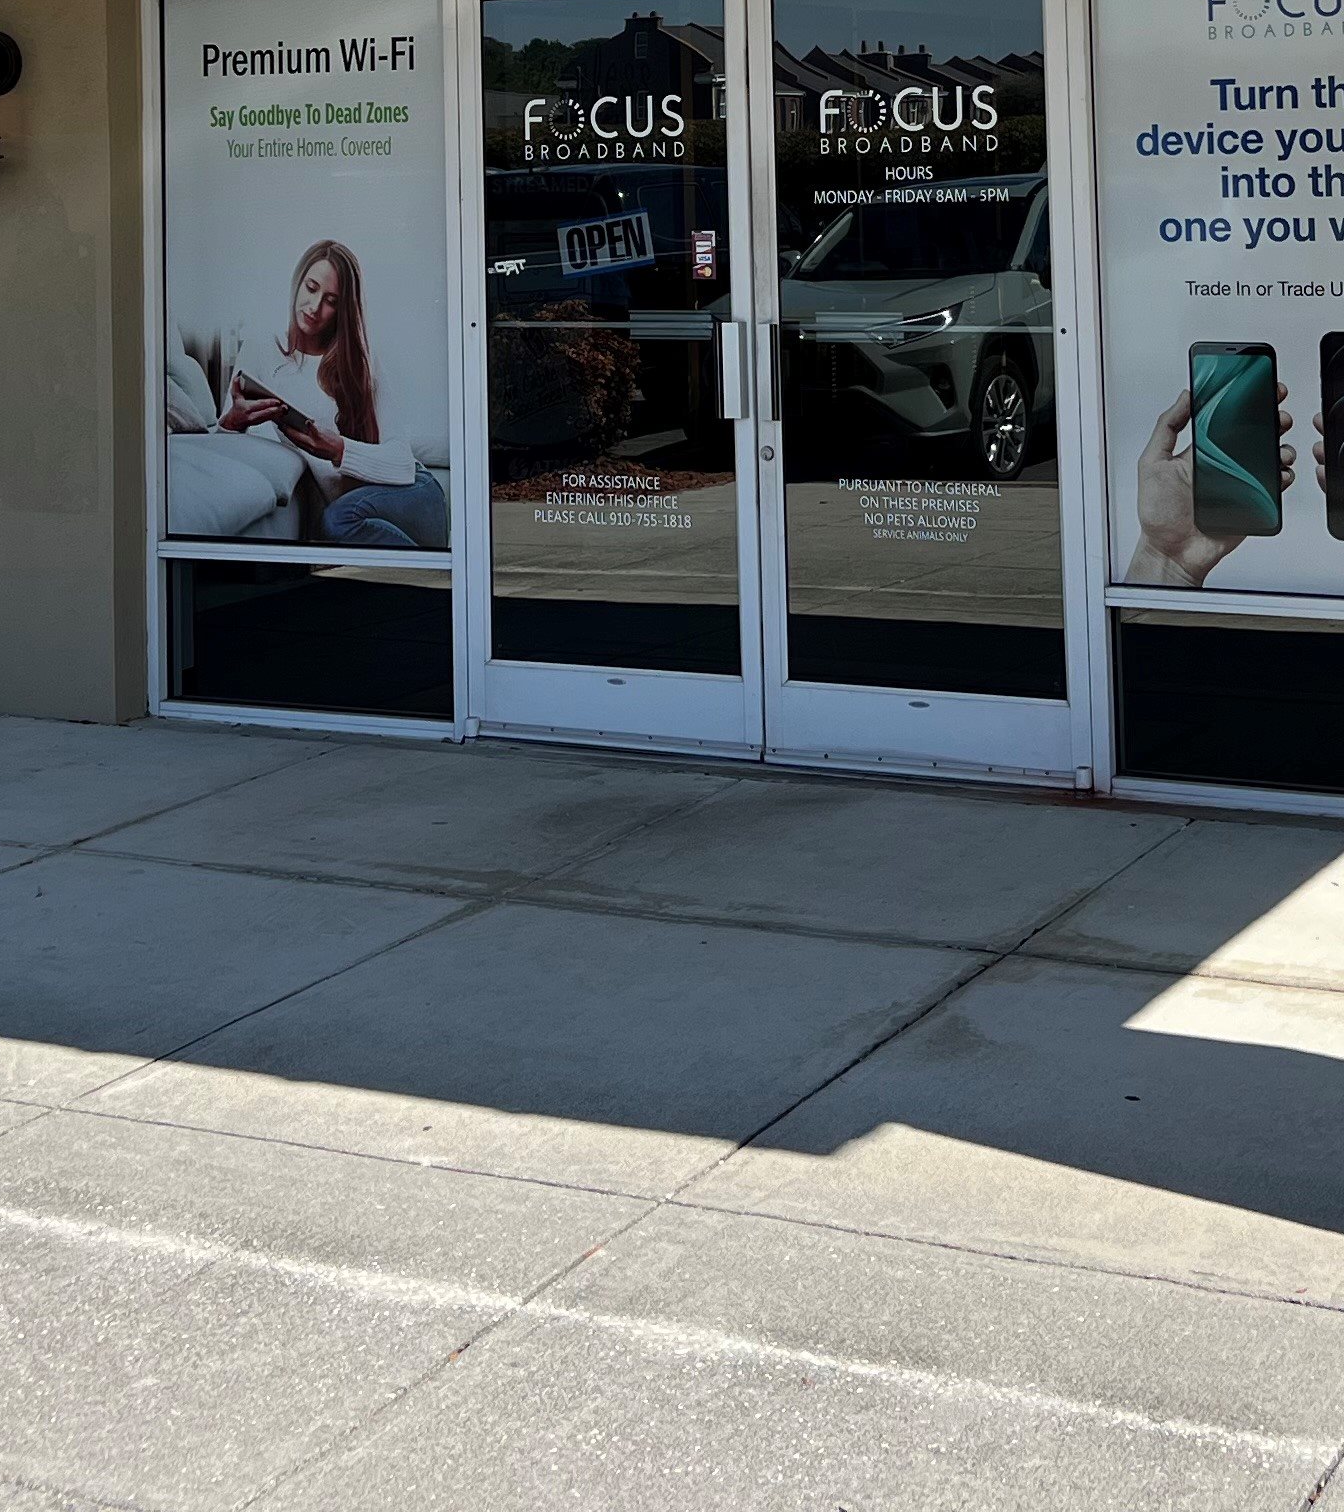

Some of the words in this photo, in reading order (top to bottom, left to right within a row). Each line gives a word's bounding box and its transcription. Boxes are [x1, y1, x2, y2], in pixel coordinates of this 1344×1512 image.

[202, 41, 331, 77] Premium
[339, 36, 415, 72] Wi-Fi
[1210, 77, 1299, 111] Turn
[210, 106, 234, 130] Say
[239, 104, 301, 129] Goodbye
[305, 104, 321, 125] To
[325, 102, 362, 125] Dead
[366, 102, 409, 124] Zones
[524, 94, 685, 140] FOCUS
[819, 85, 998, 134] FOCUS
[227, 139, 254, 158] Your
[258, 138, 293, 157] Entire
[297, 138, 337, 157] Home.
[341, 136, 392, 157] Covered
[820, 134, 998, 155] BROADBAND
[1136, 122, 1264, 156] device
[524, 141, 685, 160] BROADBAND
[885, 165, 933, 180] HOURS
[1220, 166, 1295, 198] into
[814, 190, 874, 205] MONDAY
[885, 189, 932, 203] FRIDAY
[936, 189, 967, 203] 8AM
[979, 188, 1010, 202] 5PM
[566, 216, 648, 269] OPEN
[1158, 217, 1232, 243] one
[1243, 217, 1316, 249] you
[1185, 281, 1231, 297] Trade
[1236, 281, 1251, 297] In
[1255, 284, 1273, 297] or
[1278, 281, 1325, 297] Trade
[562, 474, 586, 487] FOR
[589, 474, 661, 490] ASSISTANCE
[838, 478, 902, 493] PURSUANT
[905, 481, 922, 494] TO
[925, 481, 943, 495] NC
[945, 483, 1001, 497] GENERAL
[546, 491, 605, 506] ENTERING
[607, 493, 634, 508] THIS
[636, 495, 678, 509] OFFICE
[859, 495, 879, 508] ON
[882, 496, 918, 510] THESE
[922, 498, 980, 513] PREMISES
[534, 509, 575, 523] PLEASE
[578, 510, 607, 525] CALL
[609, 512, 692, 528] 910-755-1818
[864, 513, 884, 525] NO
[887, 513, 914, 527] PETS
[917, 515, 976, 529] ALLOWED
[873, 529, 905, 539] SERVICE
[906, 530, 944, 541] ANIMALS
[946, 531, 968, 542] ONLY
